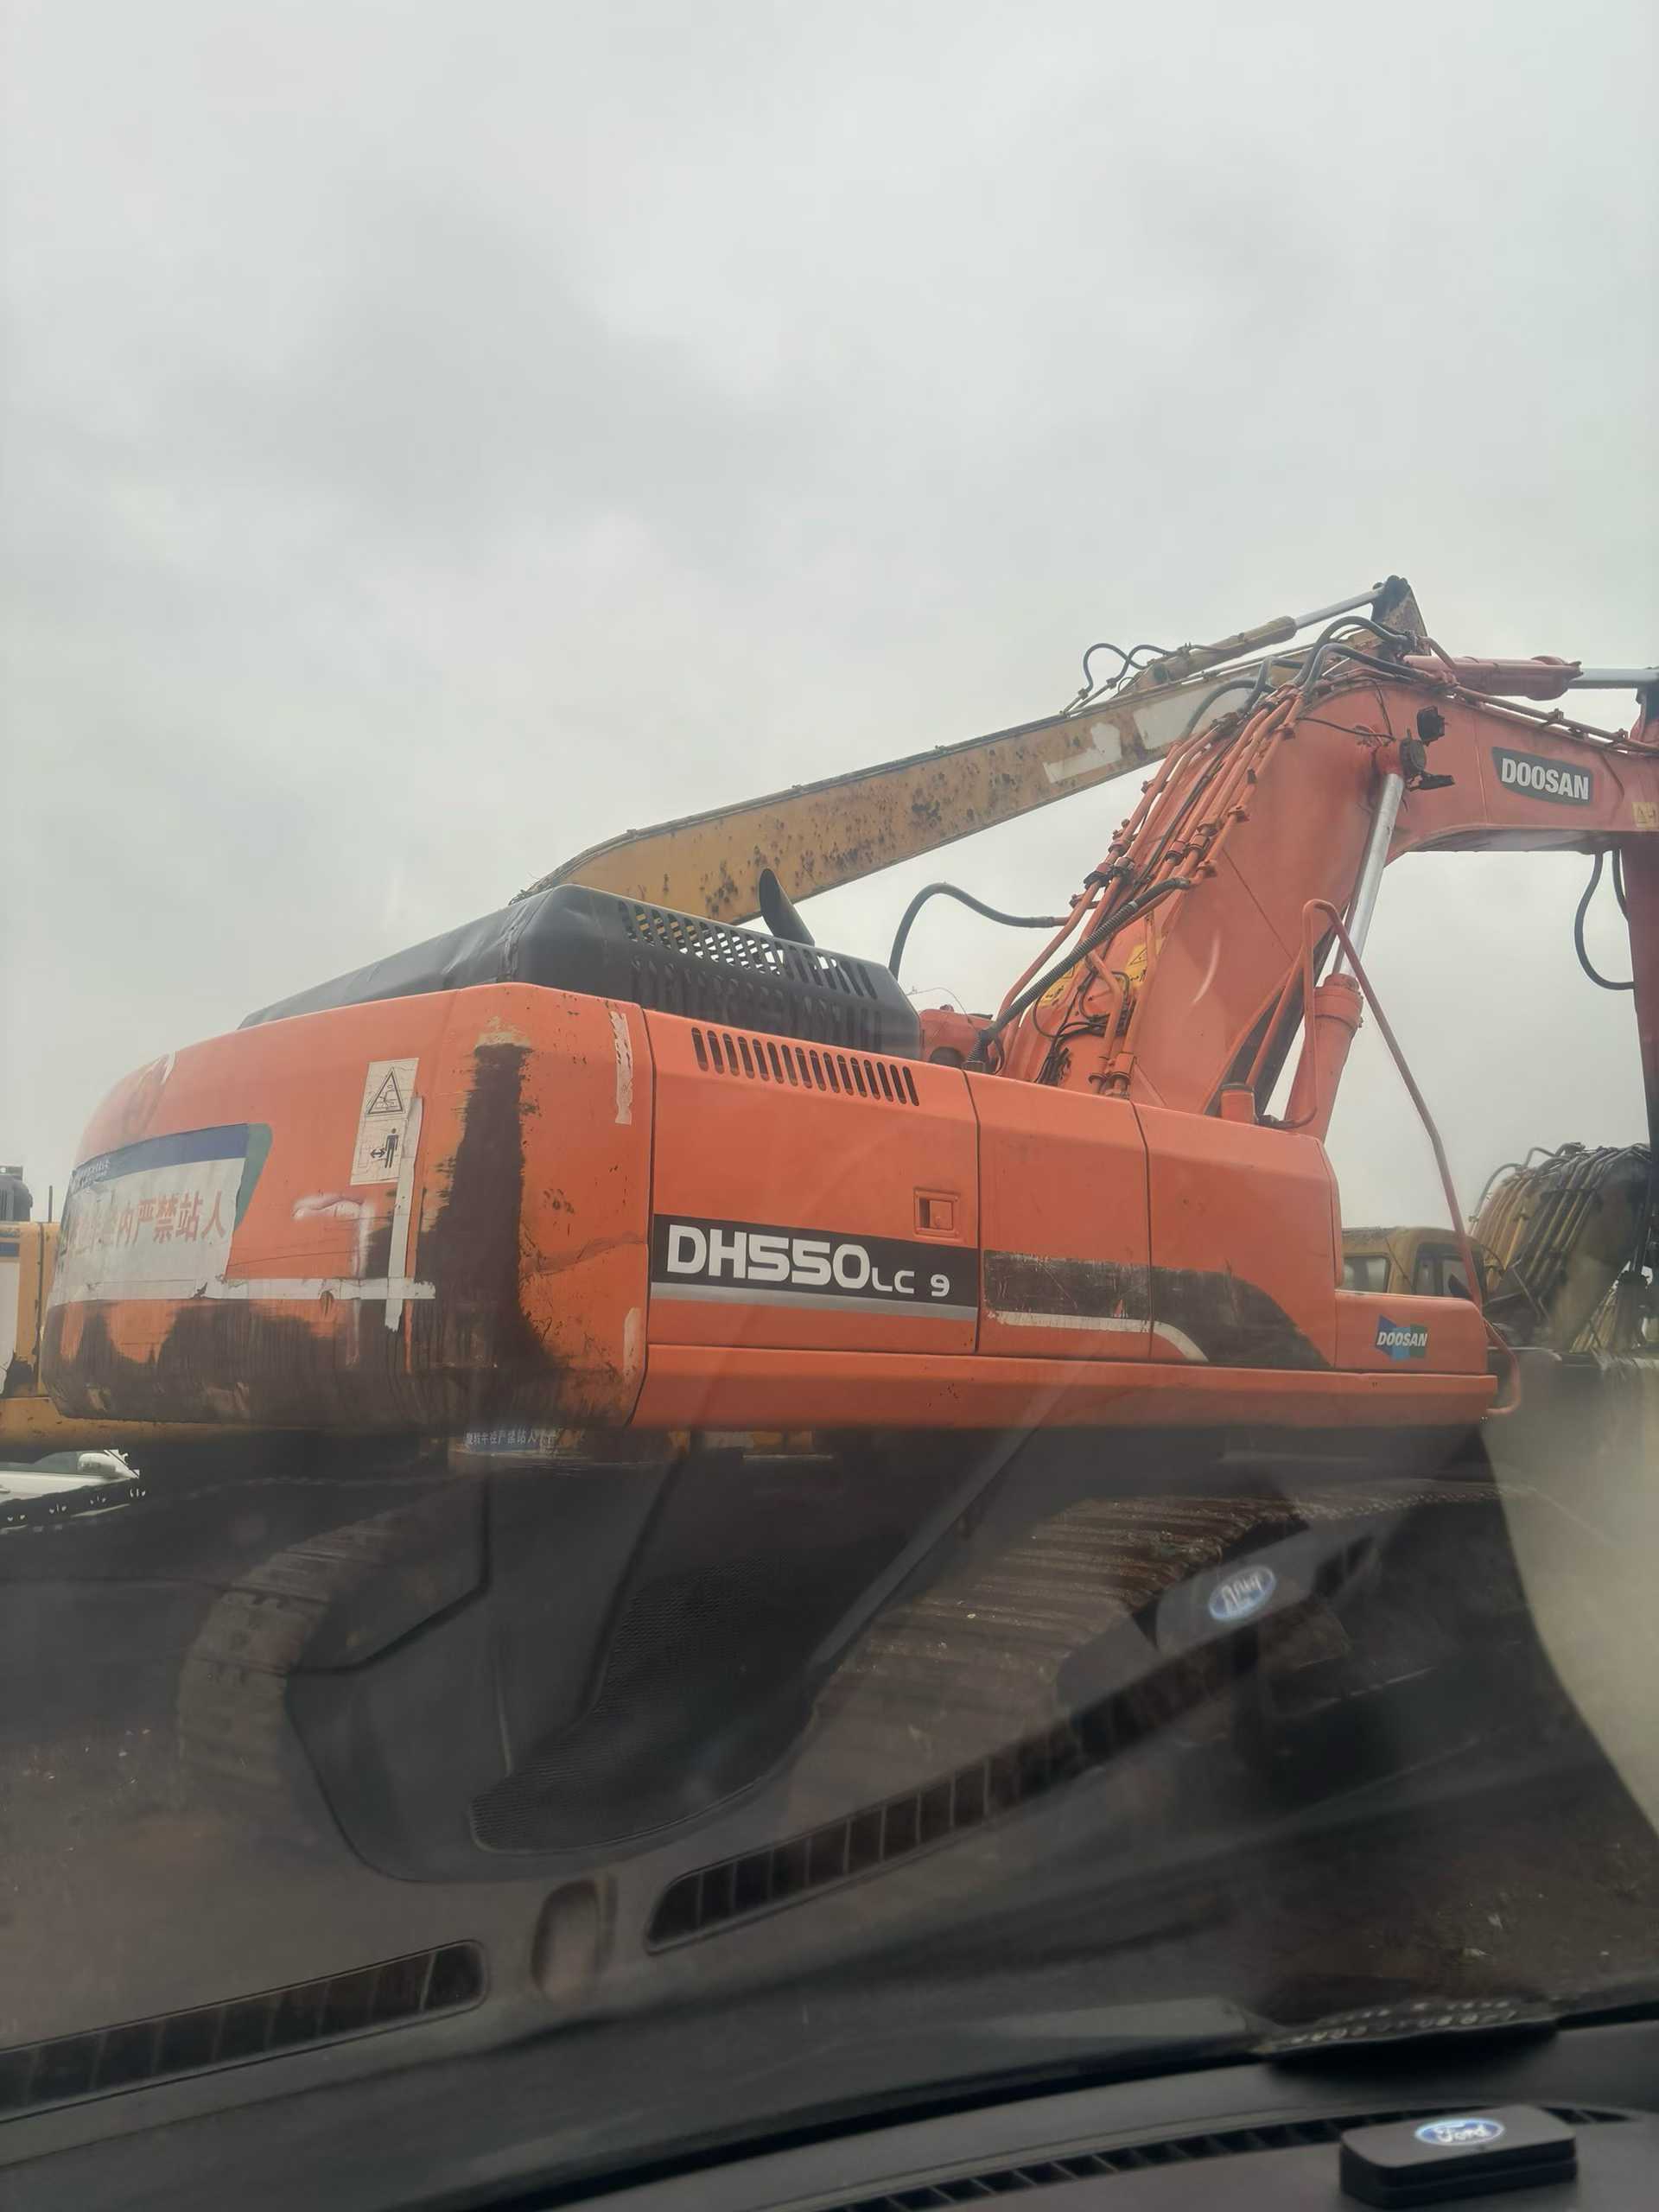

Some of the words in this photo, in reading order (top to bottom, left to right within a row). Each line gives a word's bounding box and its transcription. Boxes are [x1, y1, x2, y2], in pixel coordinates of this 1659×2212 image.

[1501, 757, 1590, 801] DOOSAN
[930, 1274, 950, 1297] 9
[1376, 1332, 1428, 1346] DOOSAN
[1436, 2125, 1487, 2143] Ford
